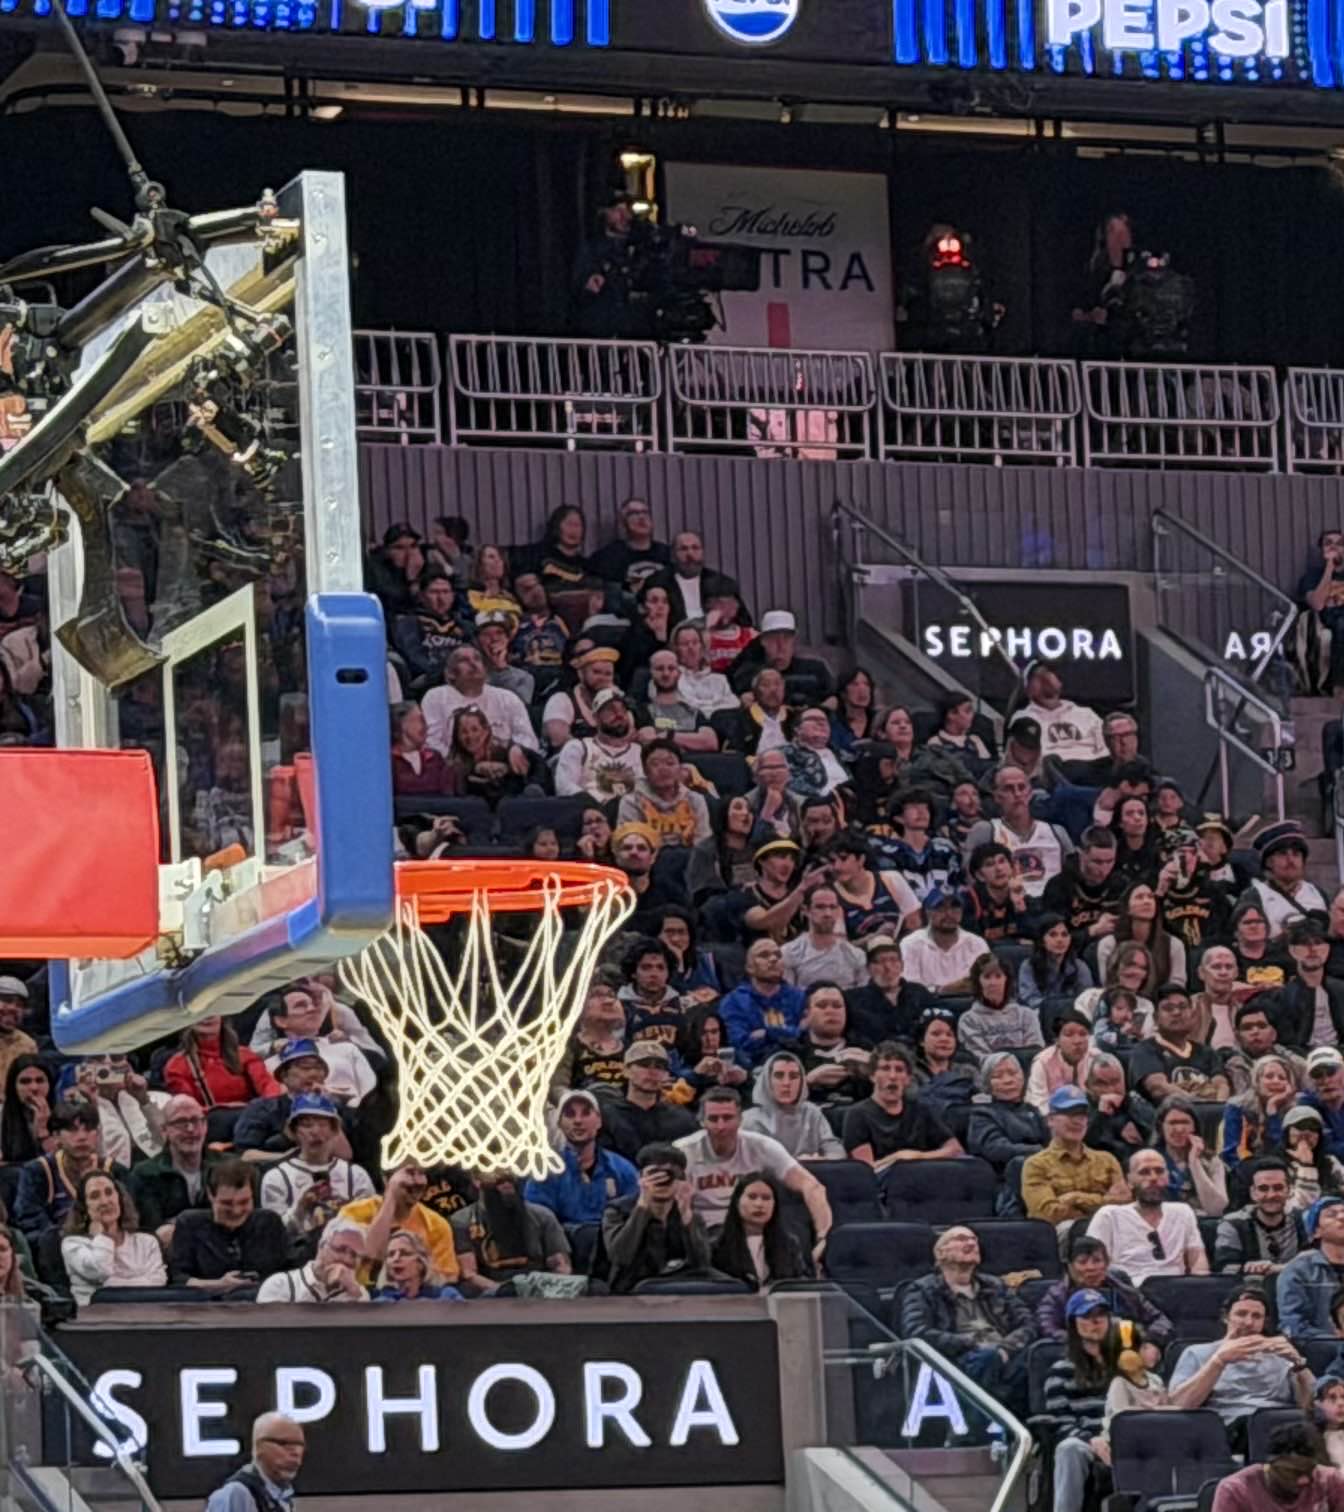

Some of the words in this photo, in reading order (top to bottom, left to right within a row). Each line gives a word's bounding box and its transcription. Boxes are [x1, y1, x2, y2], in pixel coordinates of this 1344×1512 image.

[1047, 0, 1290, 58] PEPSI
[760, 250, 875, 292] TRA
[924, 625, 1123, 661] SEPHORA
[91, 1360, 740, 1460] SEPHORA
